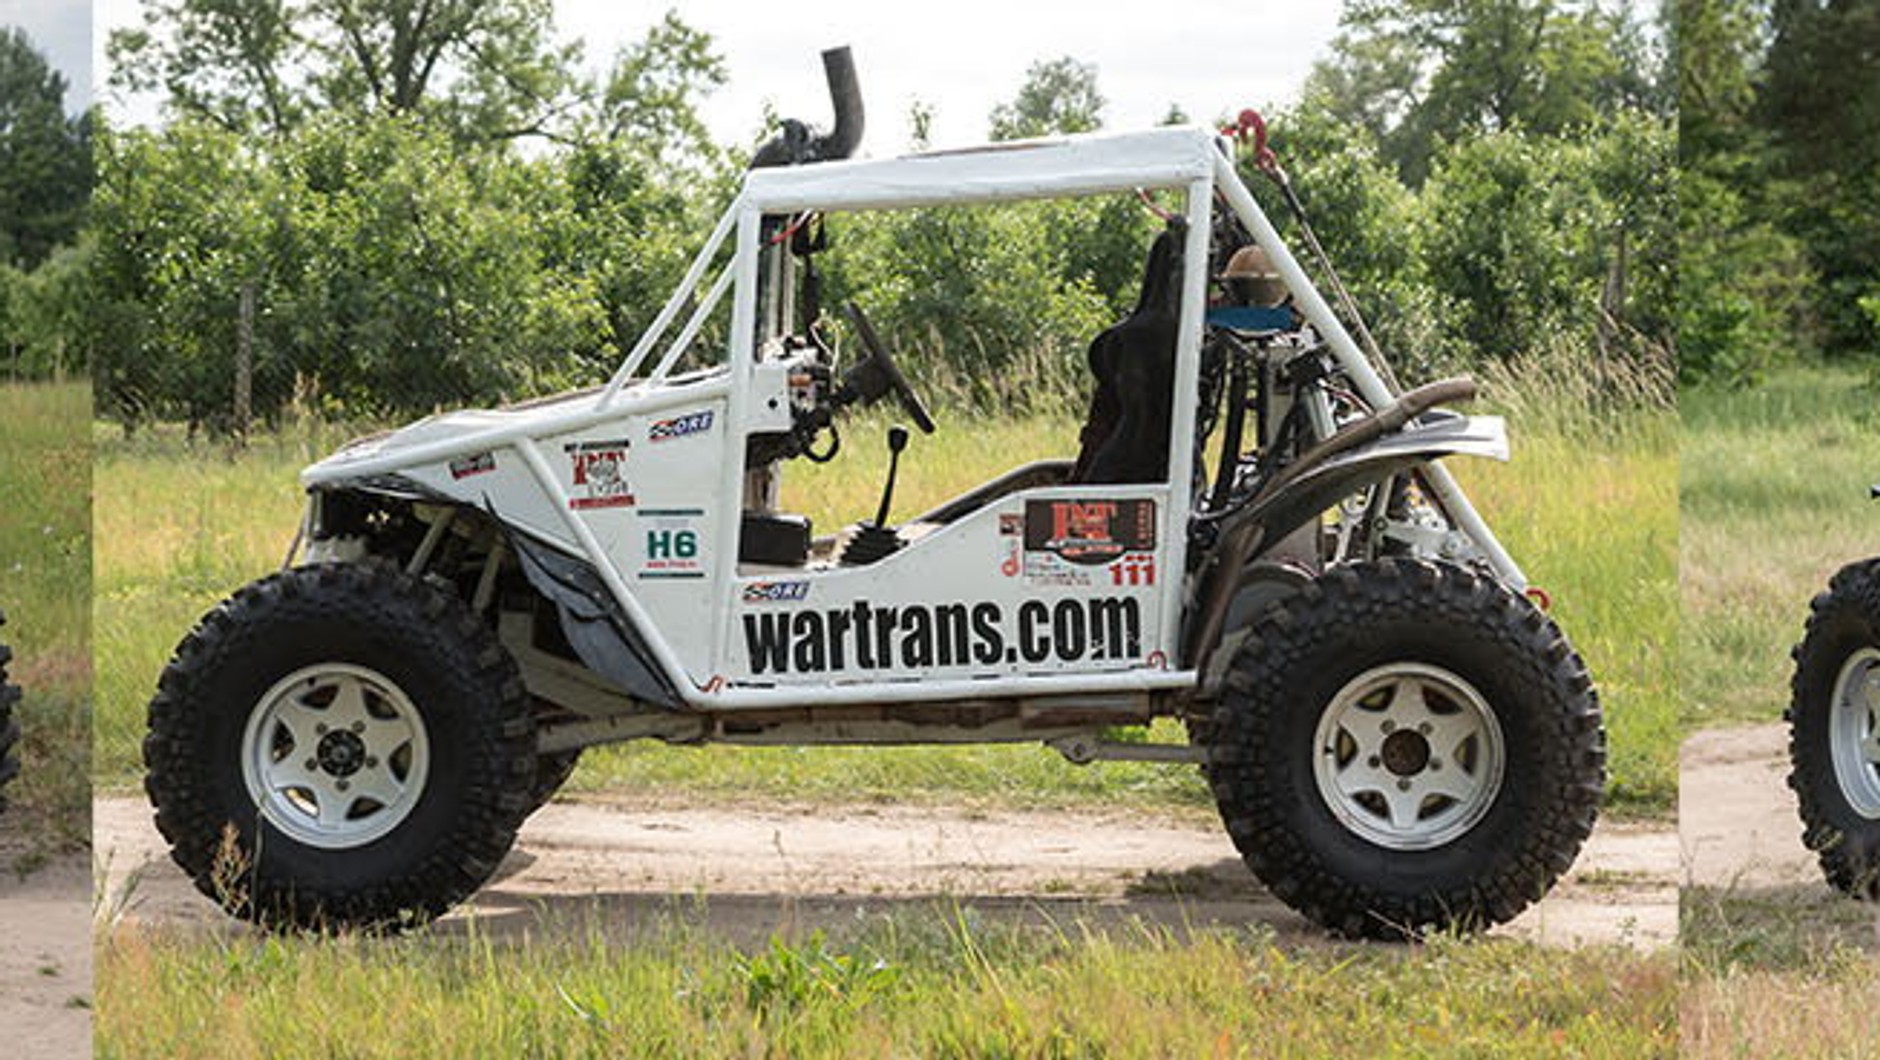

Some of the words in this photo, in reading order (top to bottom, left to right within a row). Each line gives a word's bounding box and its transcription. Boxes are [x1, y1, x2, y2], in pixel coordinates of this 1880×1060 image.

[647, 530, 697, 559] H6
[1109, 563, 1155, 586] 111
[743, 596, 1140, 675] wartrans.com
